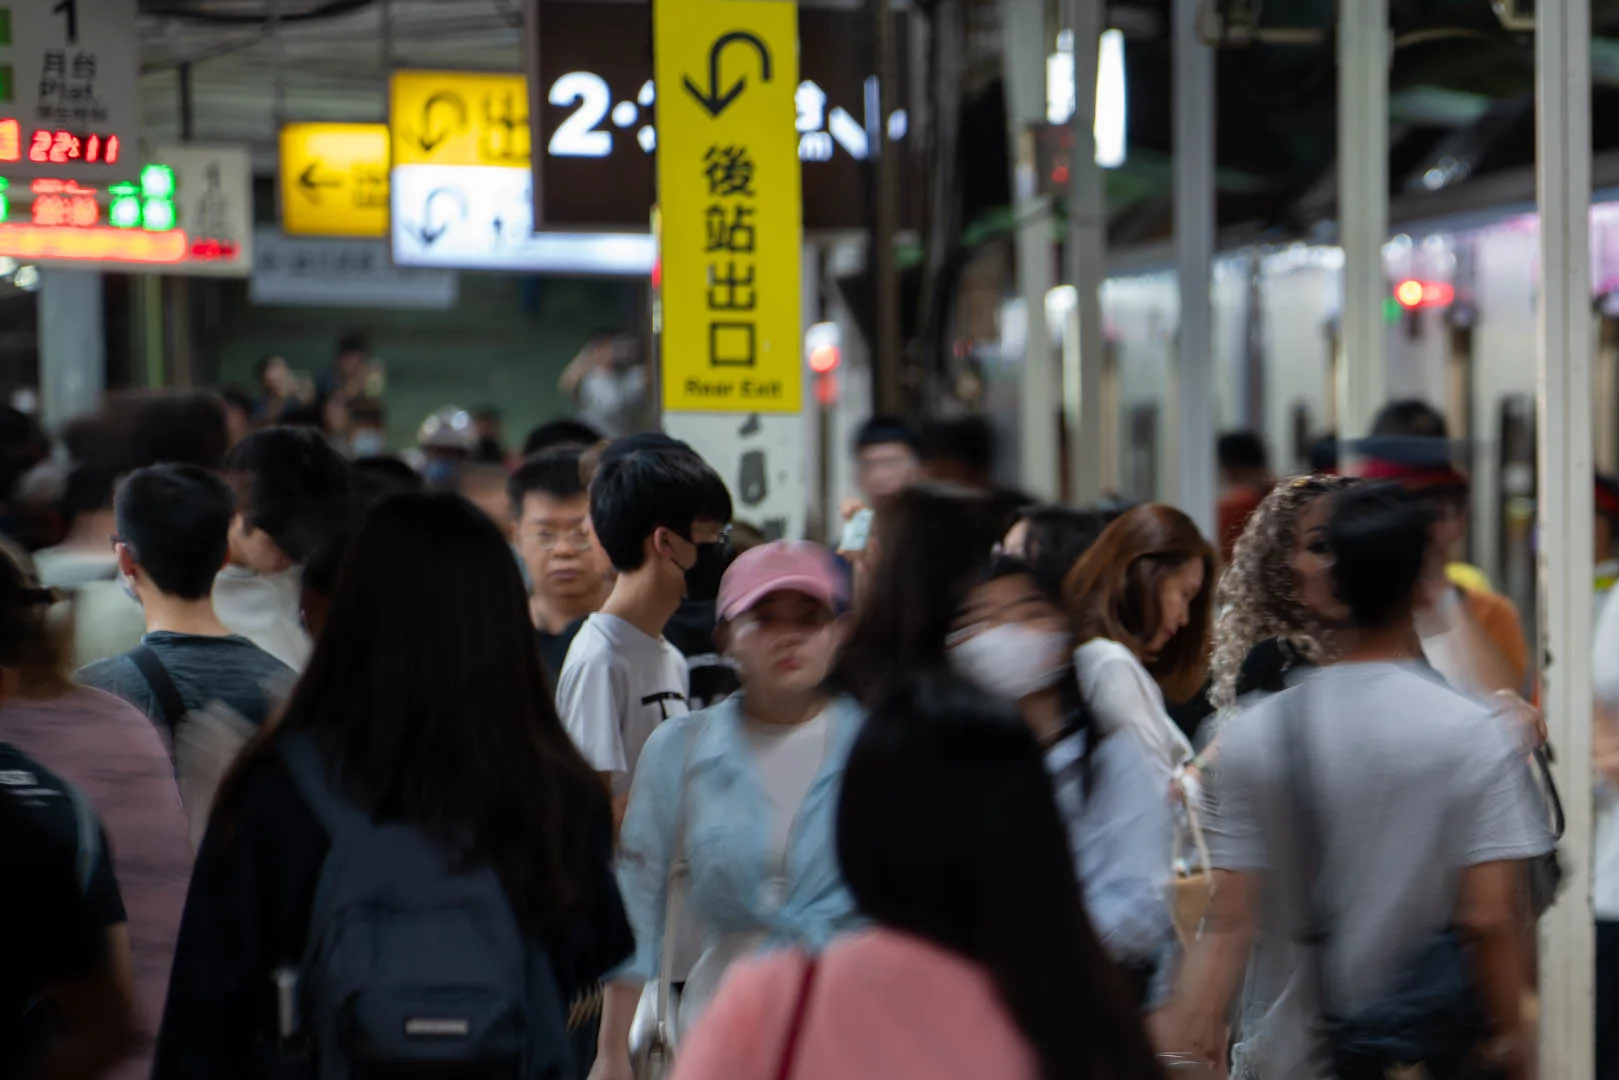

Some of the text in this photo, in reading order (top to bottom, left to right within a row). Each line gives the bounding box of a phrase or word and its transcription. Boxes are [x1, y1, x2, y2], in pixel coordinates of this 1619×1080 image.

[29, 129, 119, 162] 22:11
[703, 144, 756, 368] 後站出口
[684, 378, 782, 398] Rear Exit
